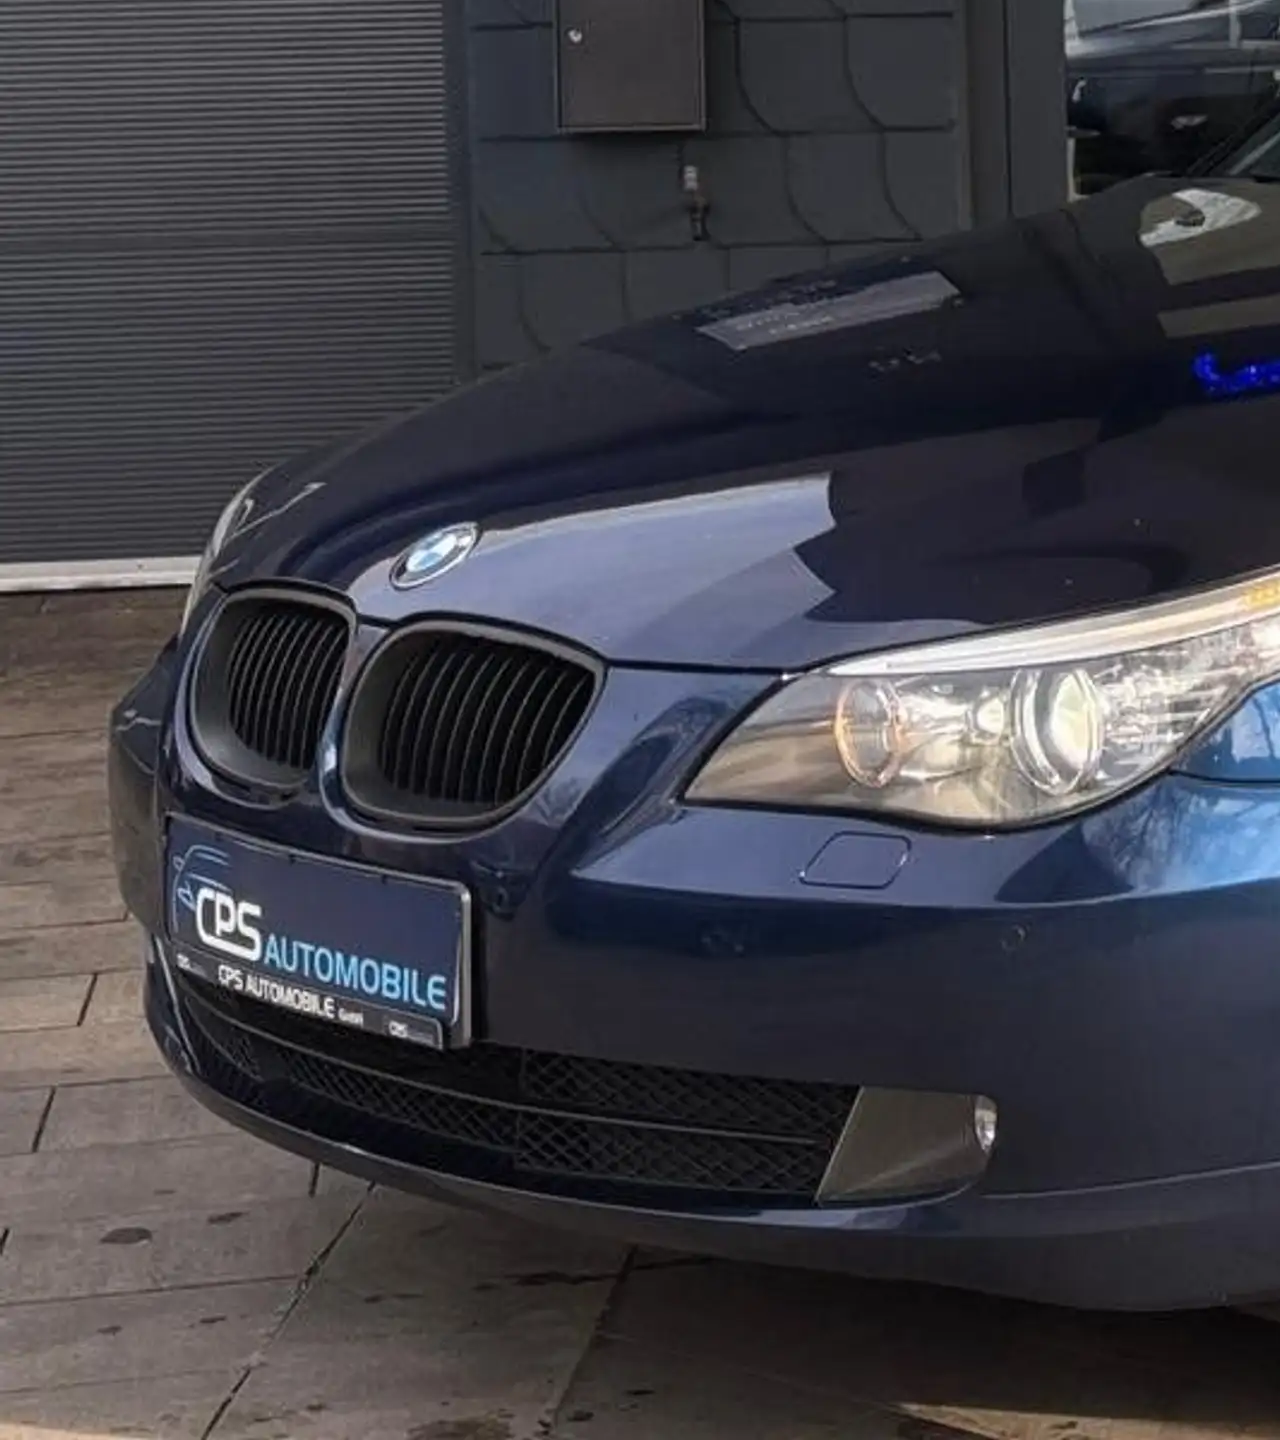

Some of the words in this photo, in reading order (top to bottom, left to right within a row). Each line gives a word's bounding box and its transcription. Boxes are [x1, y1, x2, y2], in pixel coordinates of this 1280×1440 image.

[196, 887, 262, 961] CPS
[263, 933, 447, 1011] AUTOMOBILE
[217, 964, 245, 991] CPS
[243, 974, 336, 1020] AUTOMOBILE
